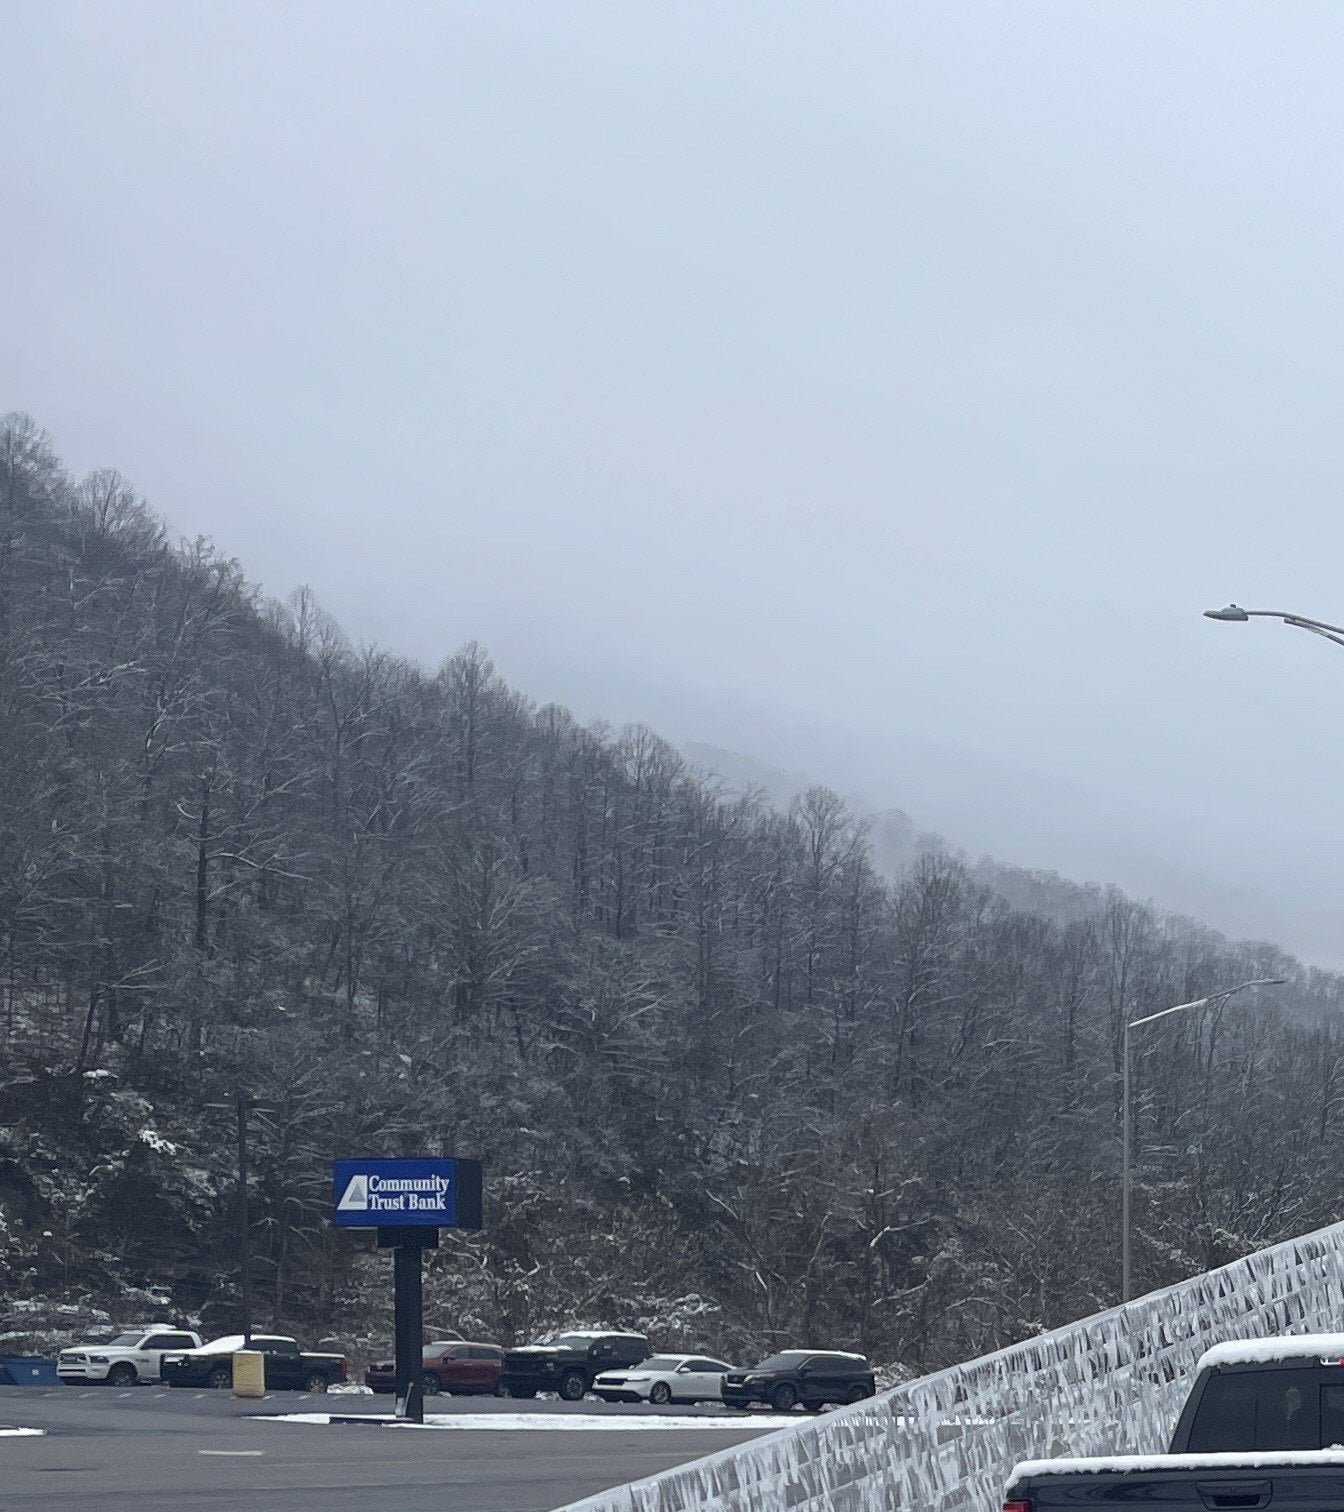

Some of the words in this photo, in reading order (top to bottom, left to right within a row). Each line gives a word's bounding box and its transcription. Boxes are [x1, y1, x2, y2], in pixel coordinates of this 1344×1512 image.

[368, 1174, 450, 1194] Community
[368, 1194, 405, 1210] Trust
[409, 1192, 446, 1210] Bank
